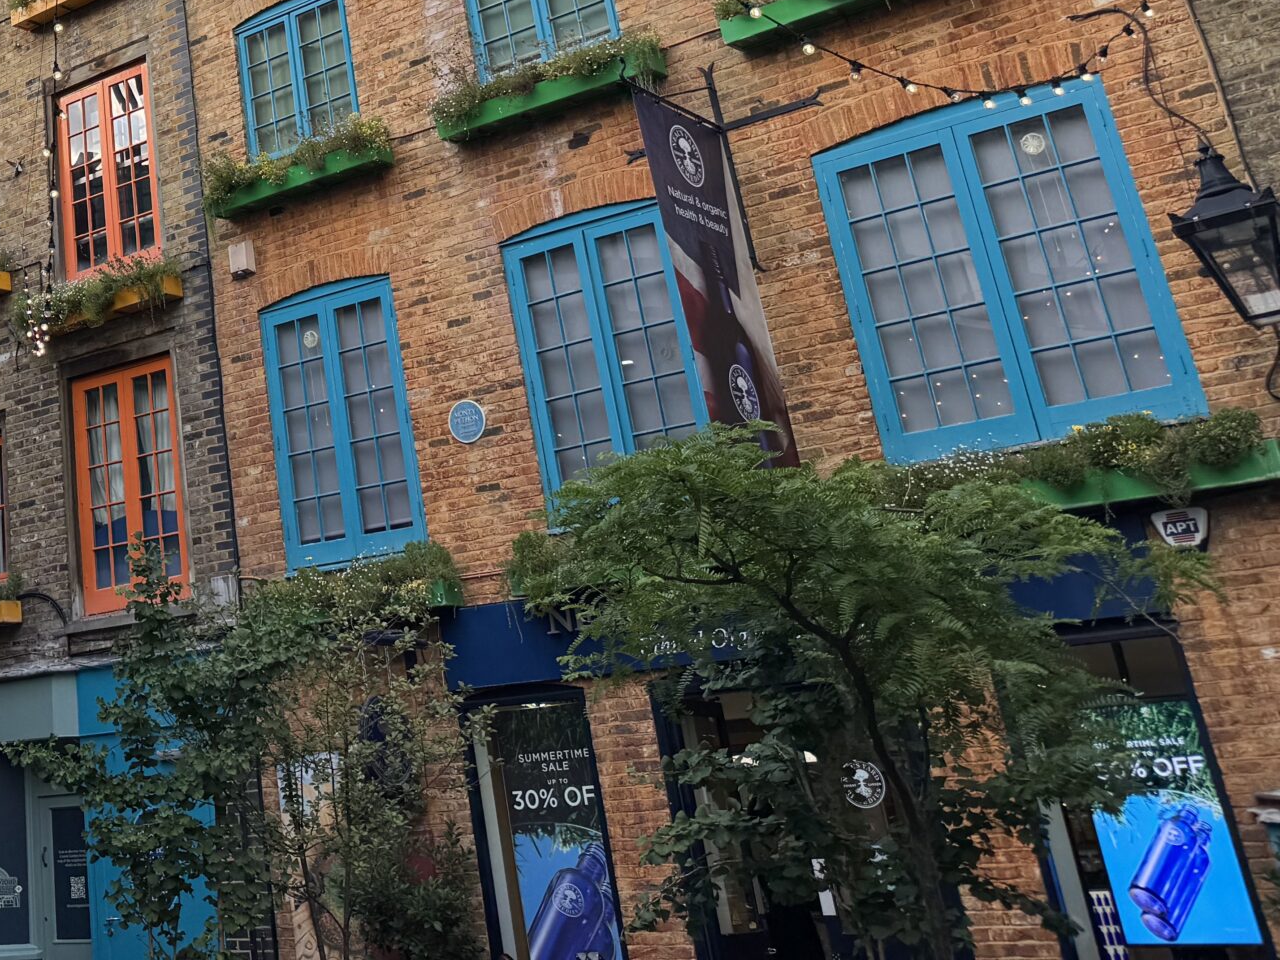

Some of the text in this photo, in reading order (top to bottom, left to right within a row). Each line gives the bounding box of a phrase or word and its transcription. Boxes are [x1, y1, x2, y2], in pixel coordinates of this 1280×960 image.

[667, 185, 728, 220] Natural & organic
[674, 204, 729, 237] health & beauty
[1166, 520, 1196, 535] APT
[1158, 736, 1185, 747] SALE
[518, 748, 590, 764] SUMMERTIME
[541, 761, 570, 773] SALE
[1152, 755, 1205, 778] OFF
[512, 788, 558, 810] 30%
